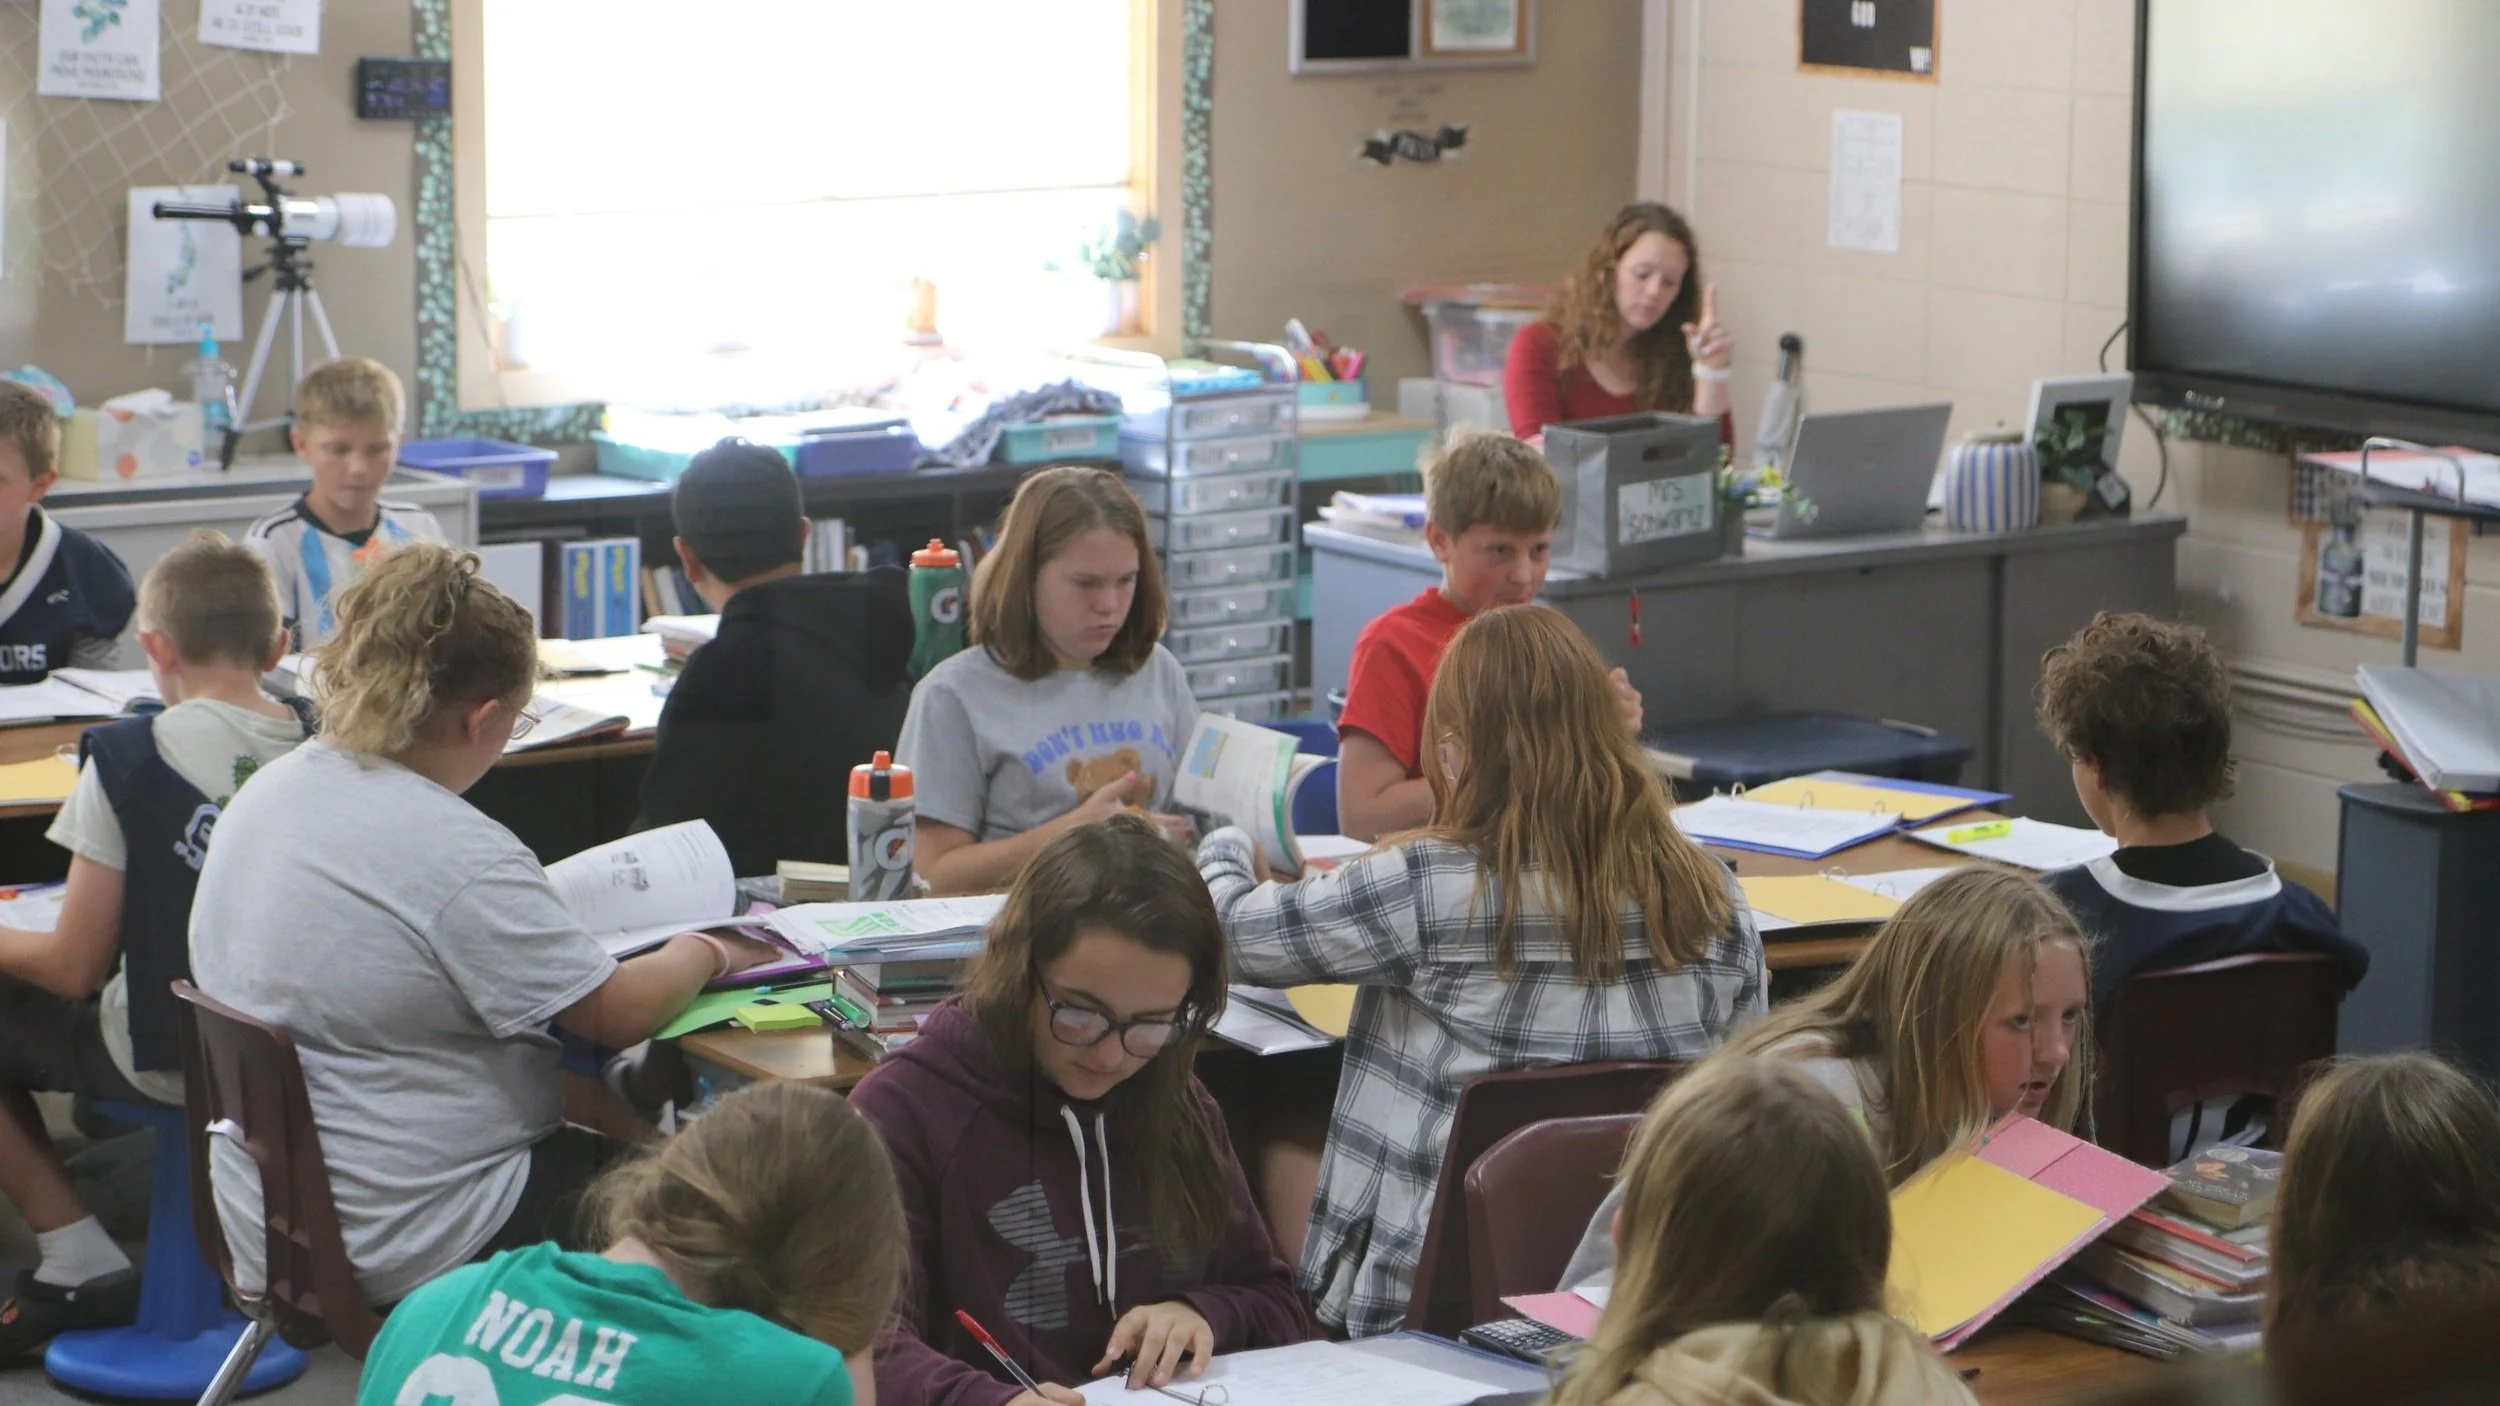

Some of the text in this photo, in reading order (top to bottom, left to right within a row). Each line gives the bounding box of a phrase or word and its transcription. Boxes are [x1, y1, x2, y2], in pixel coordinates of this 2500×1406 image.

[930, 587, 959, 624] G
[1023, 725, 1085, 774] DON'T
[1088, 720, 1143, 745] HUG
[464, 1290, 638, 1390] NOAH
